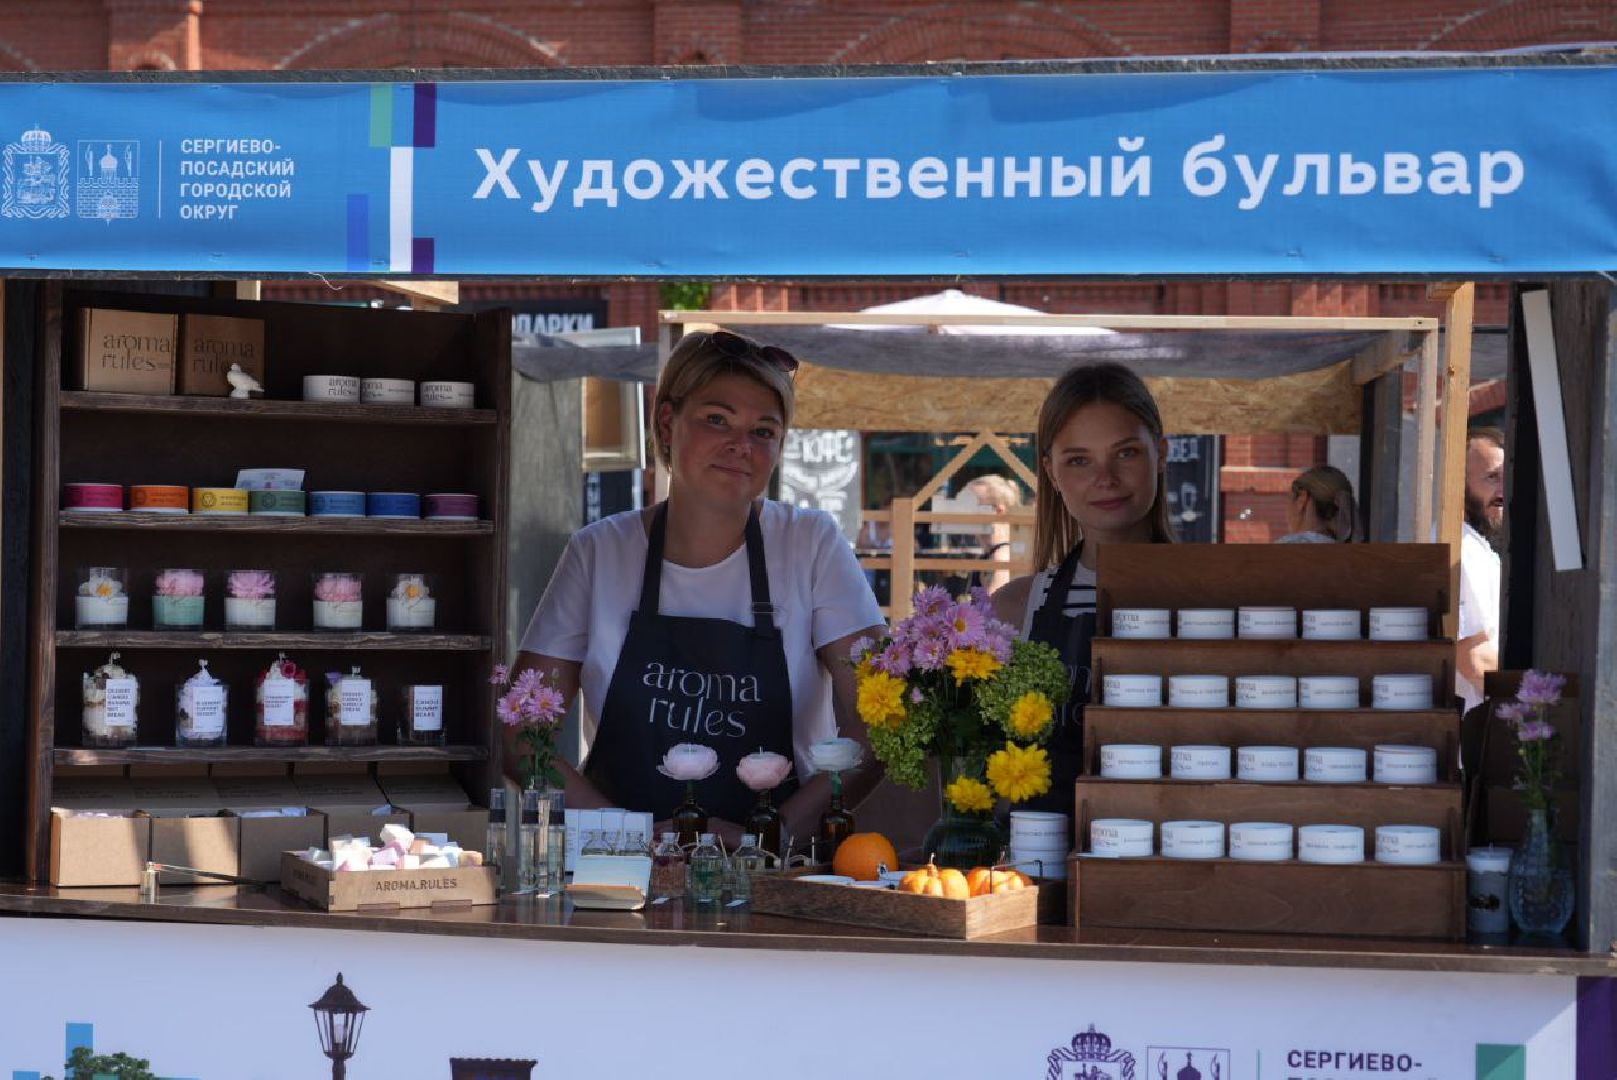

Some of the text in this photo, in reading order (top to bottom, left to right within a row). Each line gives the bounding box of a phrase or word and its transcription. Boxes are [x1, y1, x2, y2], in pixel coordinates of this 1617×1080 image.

[181, 138, 281, 154] СЕРГИЕВО-
[180, 158, 295, 178] ПОСАДСКИЙ
[472, 134, 1525, 213] Художественный бульвар
[180, 180, 291, 200] ГОРОДСКОЙ
[180, 204, 239, 219] ОКРУГ
[103, 334, 171, 354] aroma
[643, 662, 762, 702] aroma
[649, 696, 746, 737] rules
[1287, 1049, 1422, 1073] СЕРГИЕВО-
